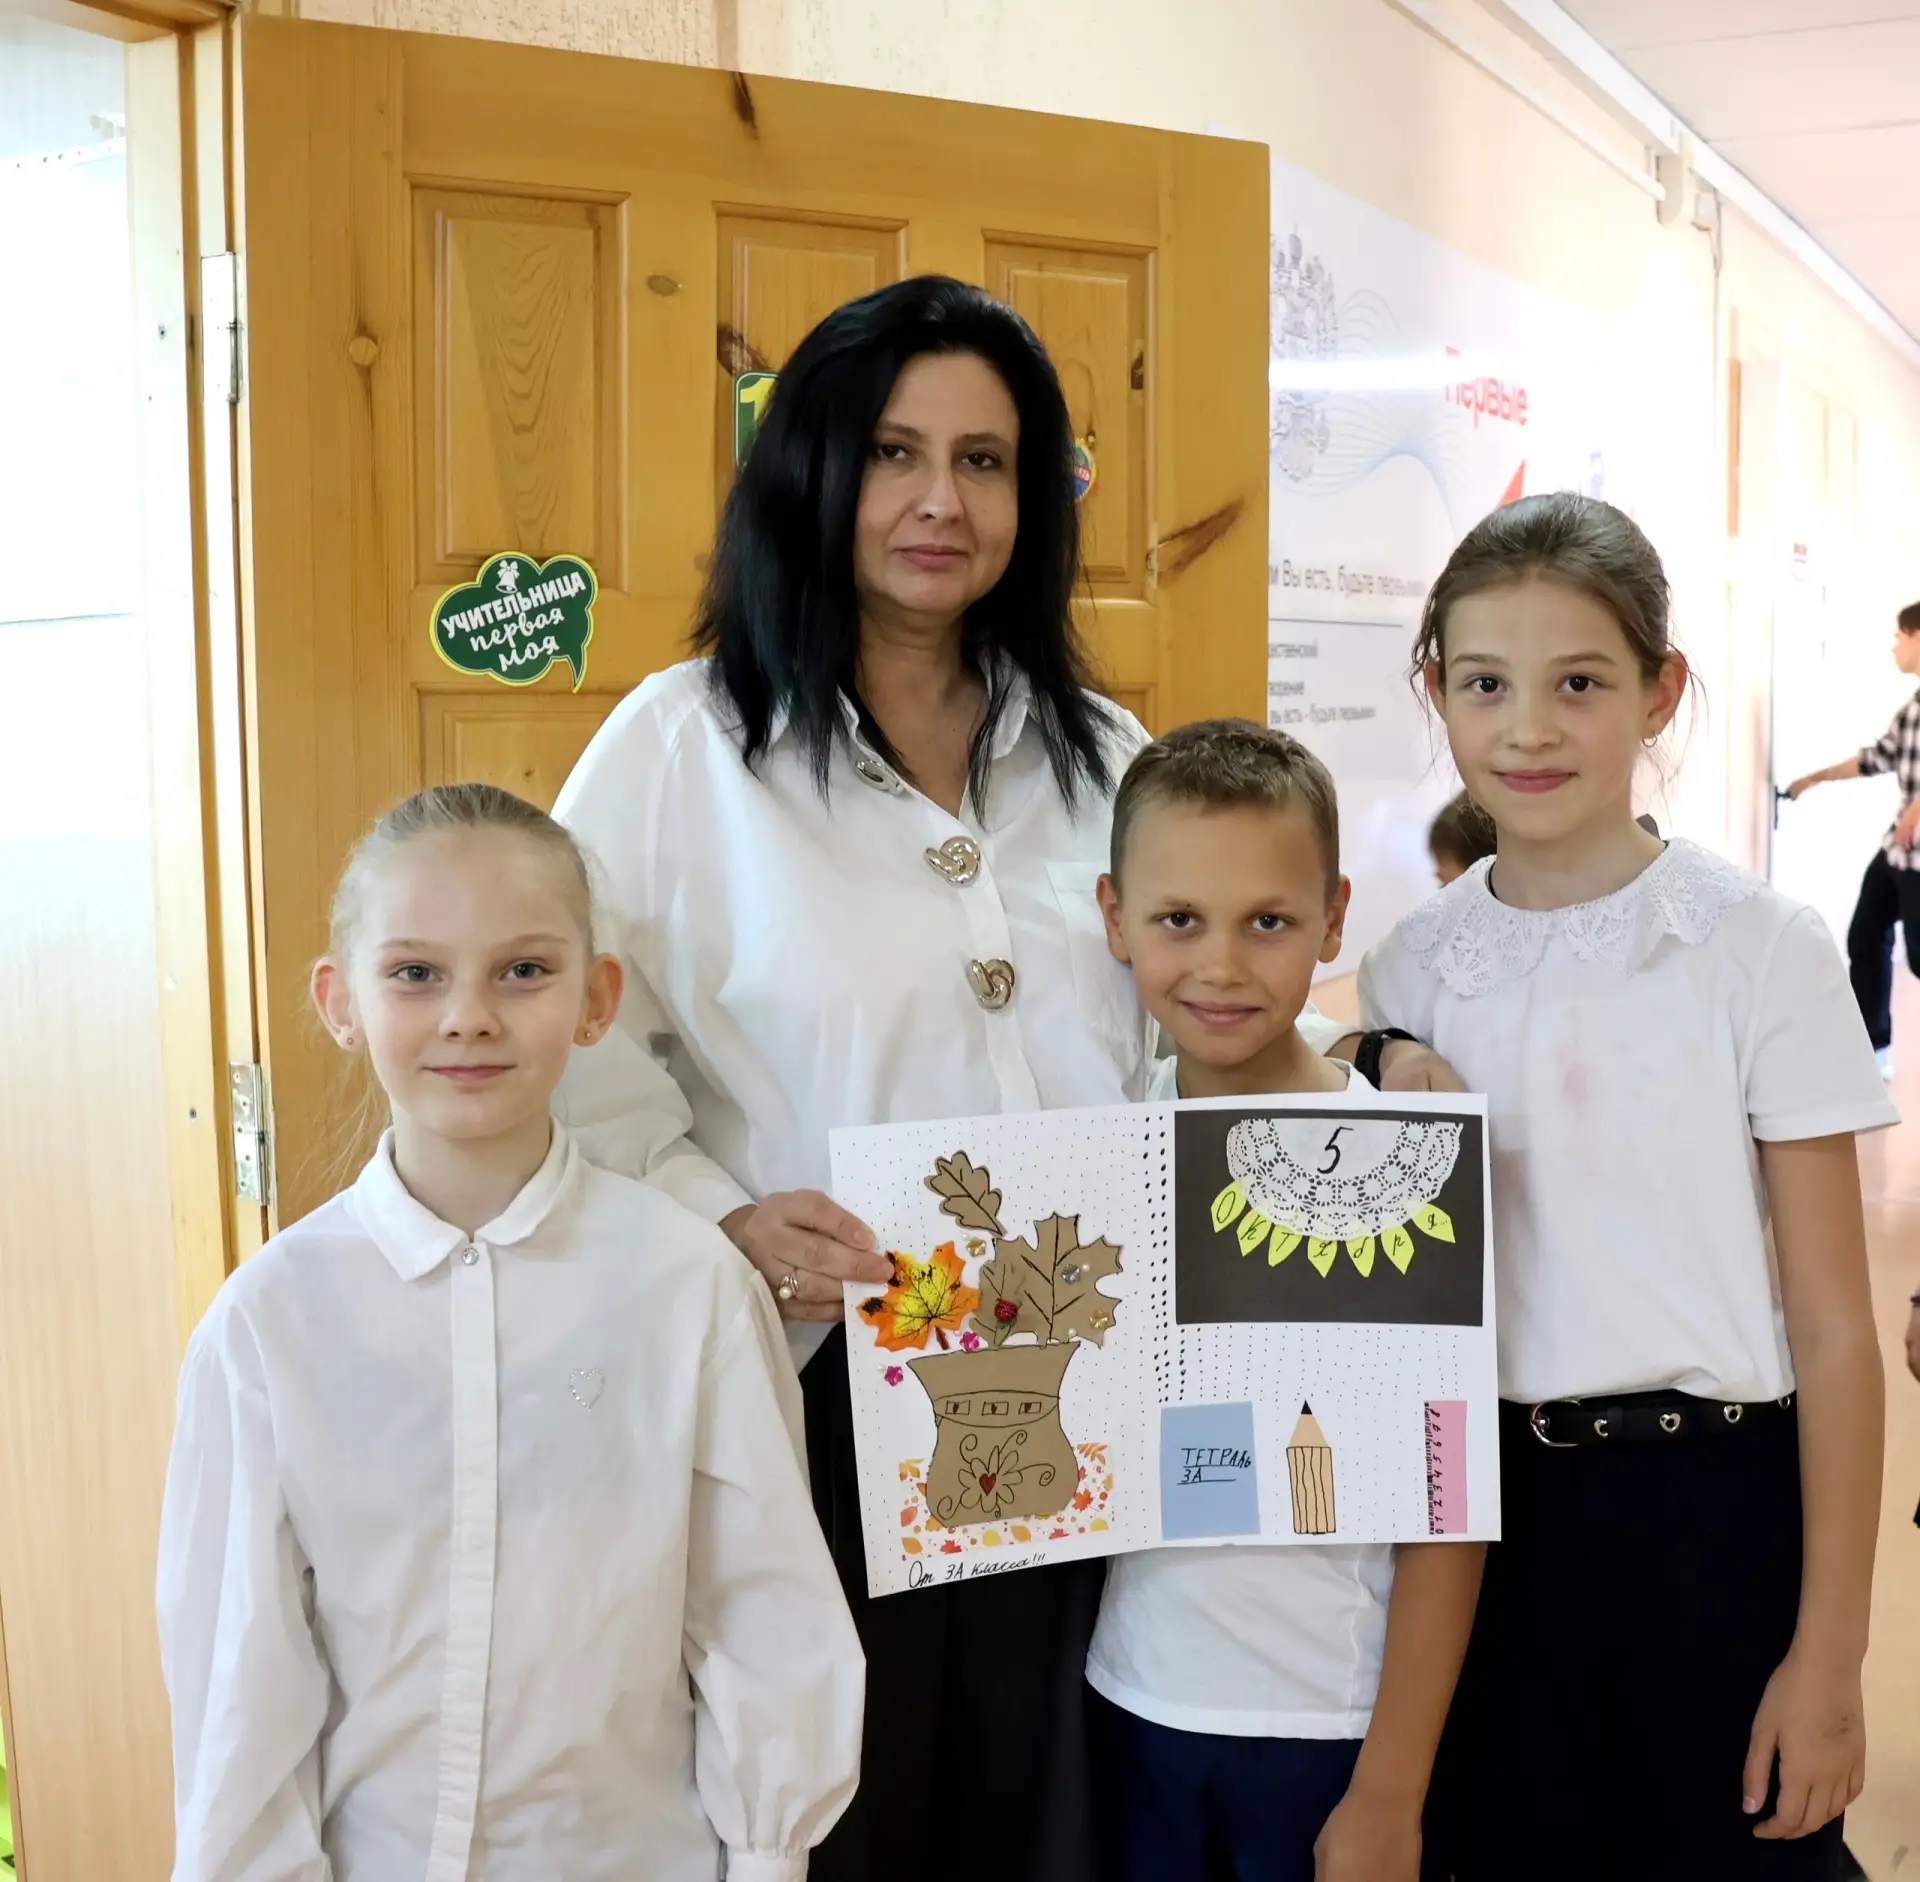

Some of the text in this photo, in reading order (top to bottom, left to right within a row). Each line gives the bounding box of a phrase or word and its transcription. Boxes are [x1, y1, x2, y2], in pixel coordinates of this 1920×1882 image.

[441, 571, 586, 639] УЧИТЕЛЬНИЦА
[470, 607, 565, 652] первая
[498, 635, 560, 673] моя
[1317, 1126, 1355, 1174] 5
[908, 1560, 935, 1588] От
